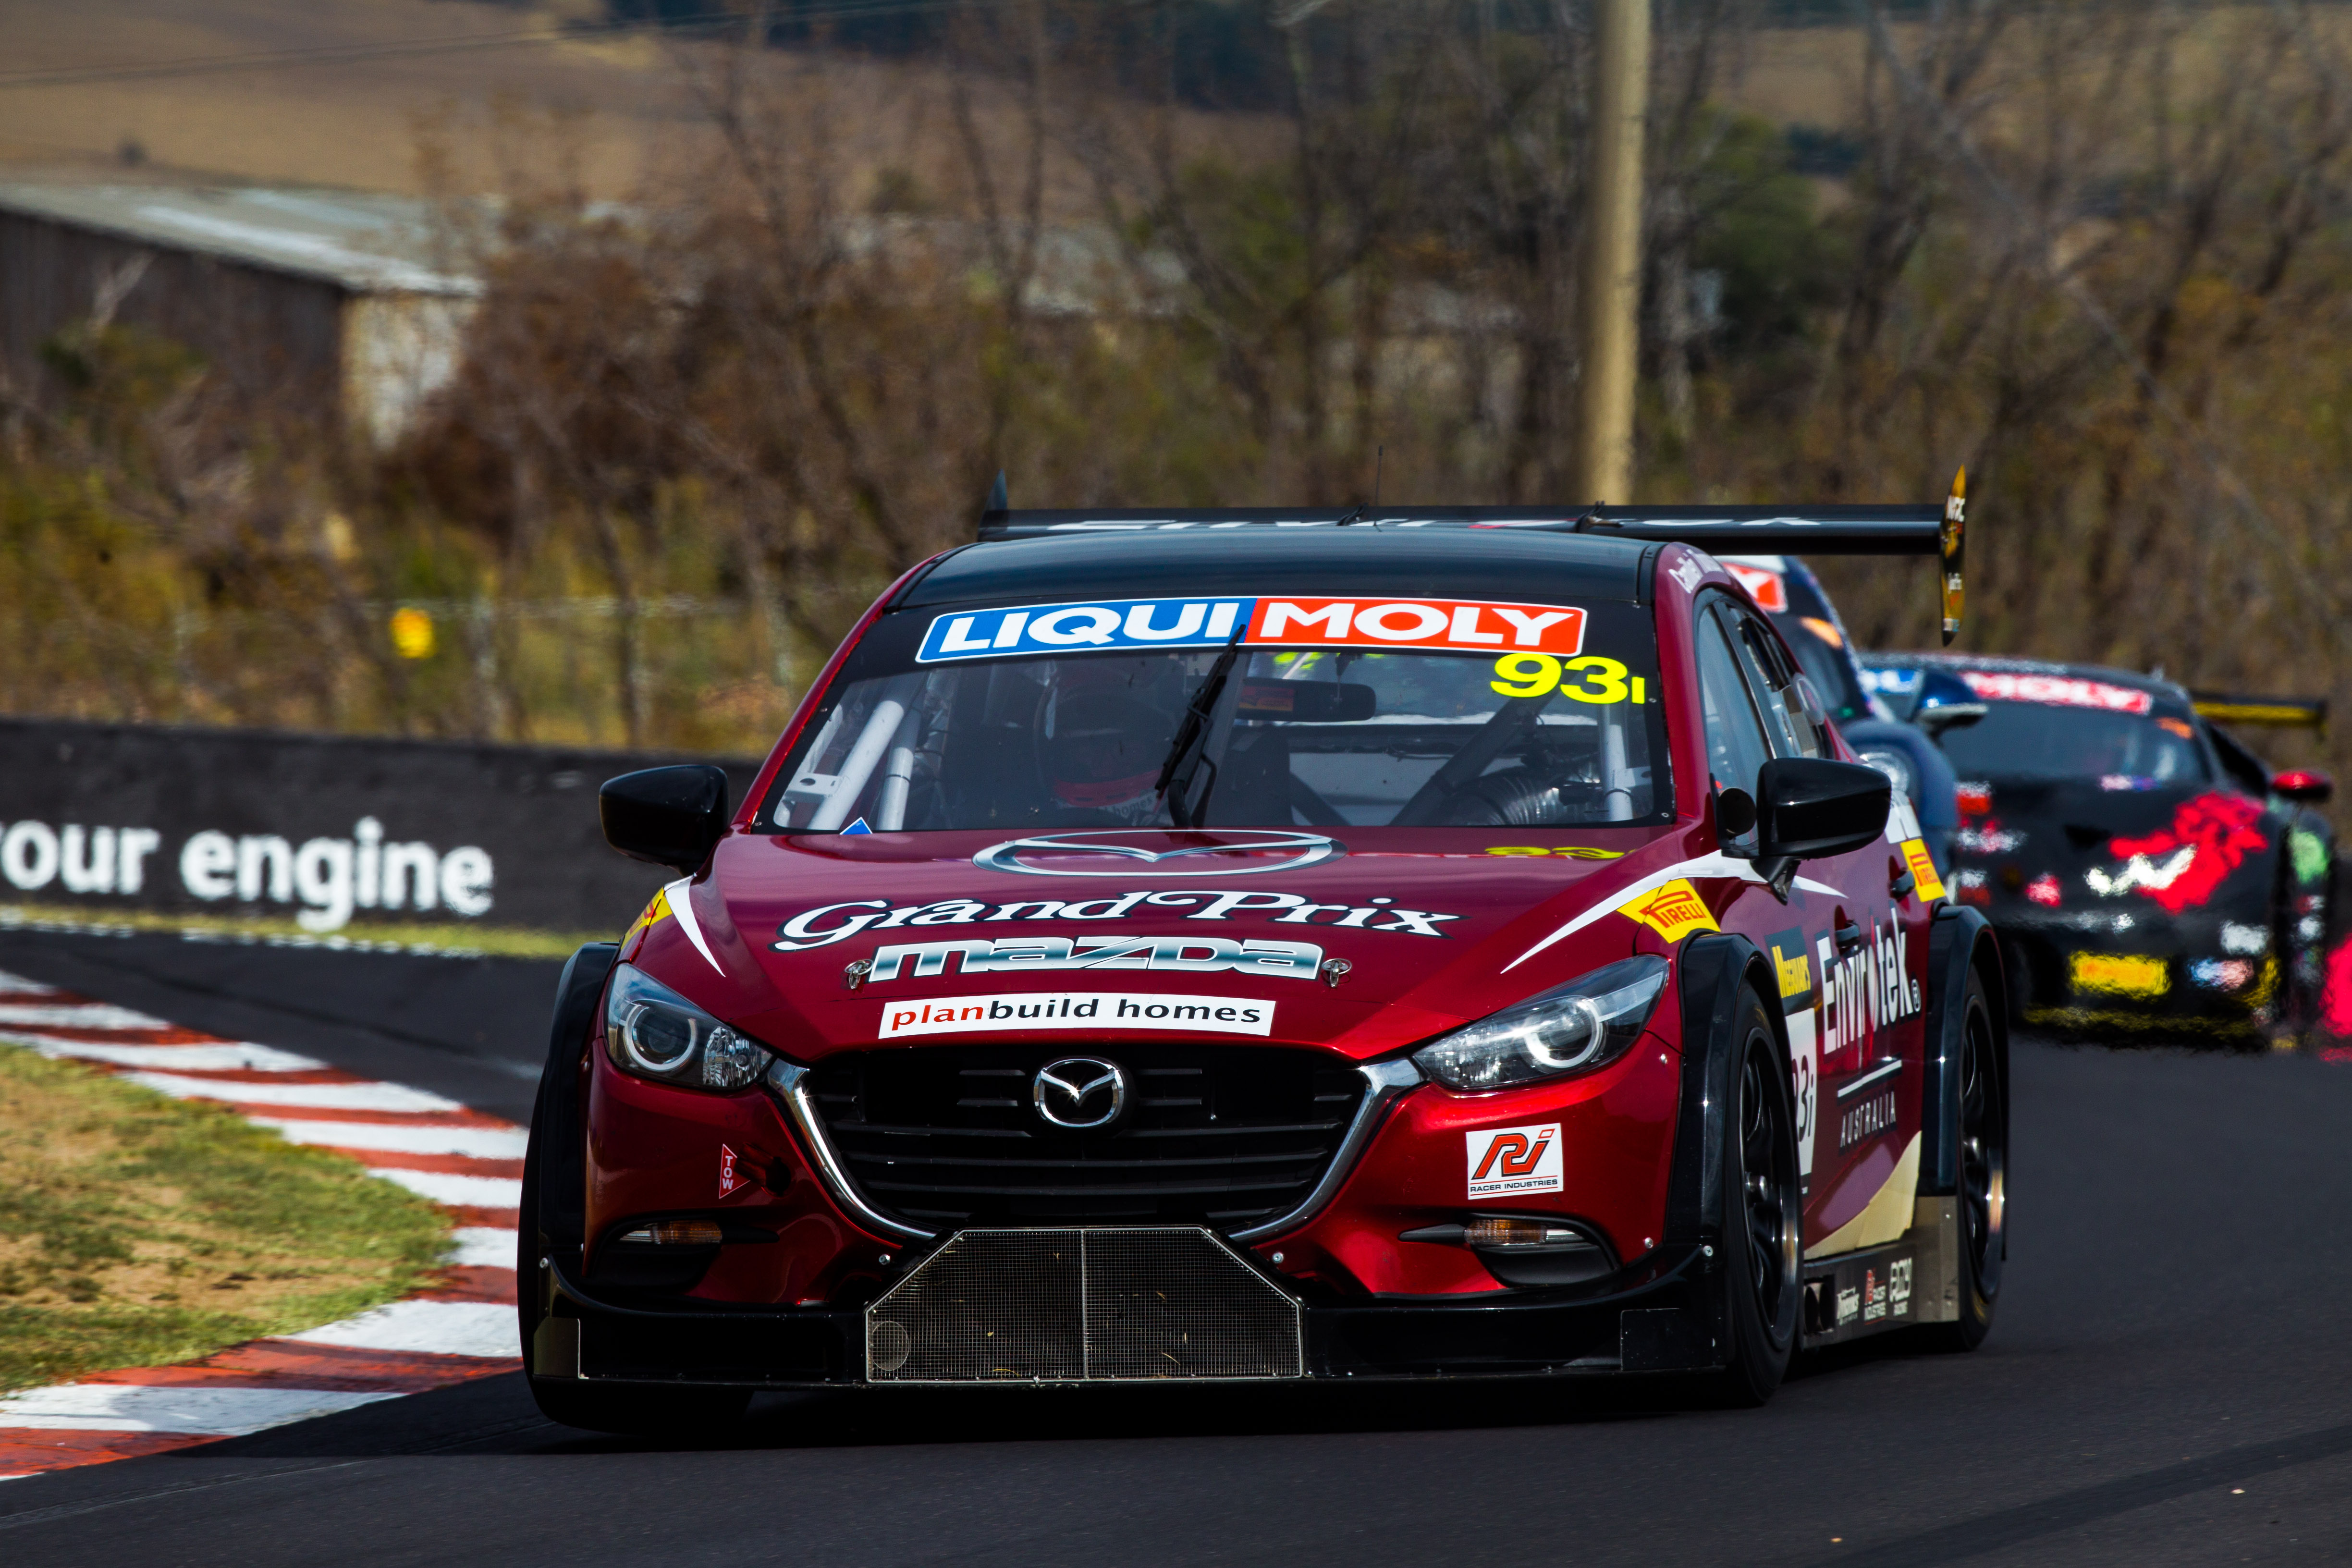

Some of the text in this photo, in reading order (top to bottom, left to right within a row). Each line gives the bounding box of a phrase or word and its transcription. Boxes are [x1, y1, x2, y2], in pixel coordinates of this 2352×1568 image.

[940, 602, 1575, 652] LIQUI MOLY
[0, 816, 494, 932] our engine
[774, 891, 1459, 950] Grand Prix
[1639, 891, 1706, 928] PIRELLI
[892, 999, 1261, 1031] planbuild homes
[1840, 1091, 1897, 1148] AUSTRALIA
[722, 1155, 734, 1190] TOW
[1470, 1179, 1558, 1192] RACER INDUSTRIES
